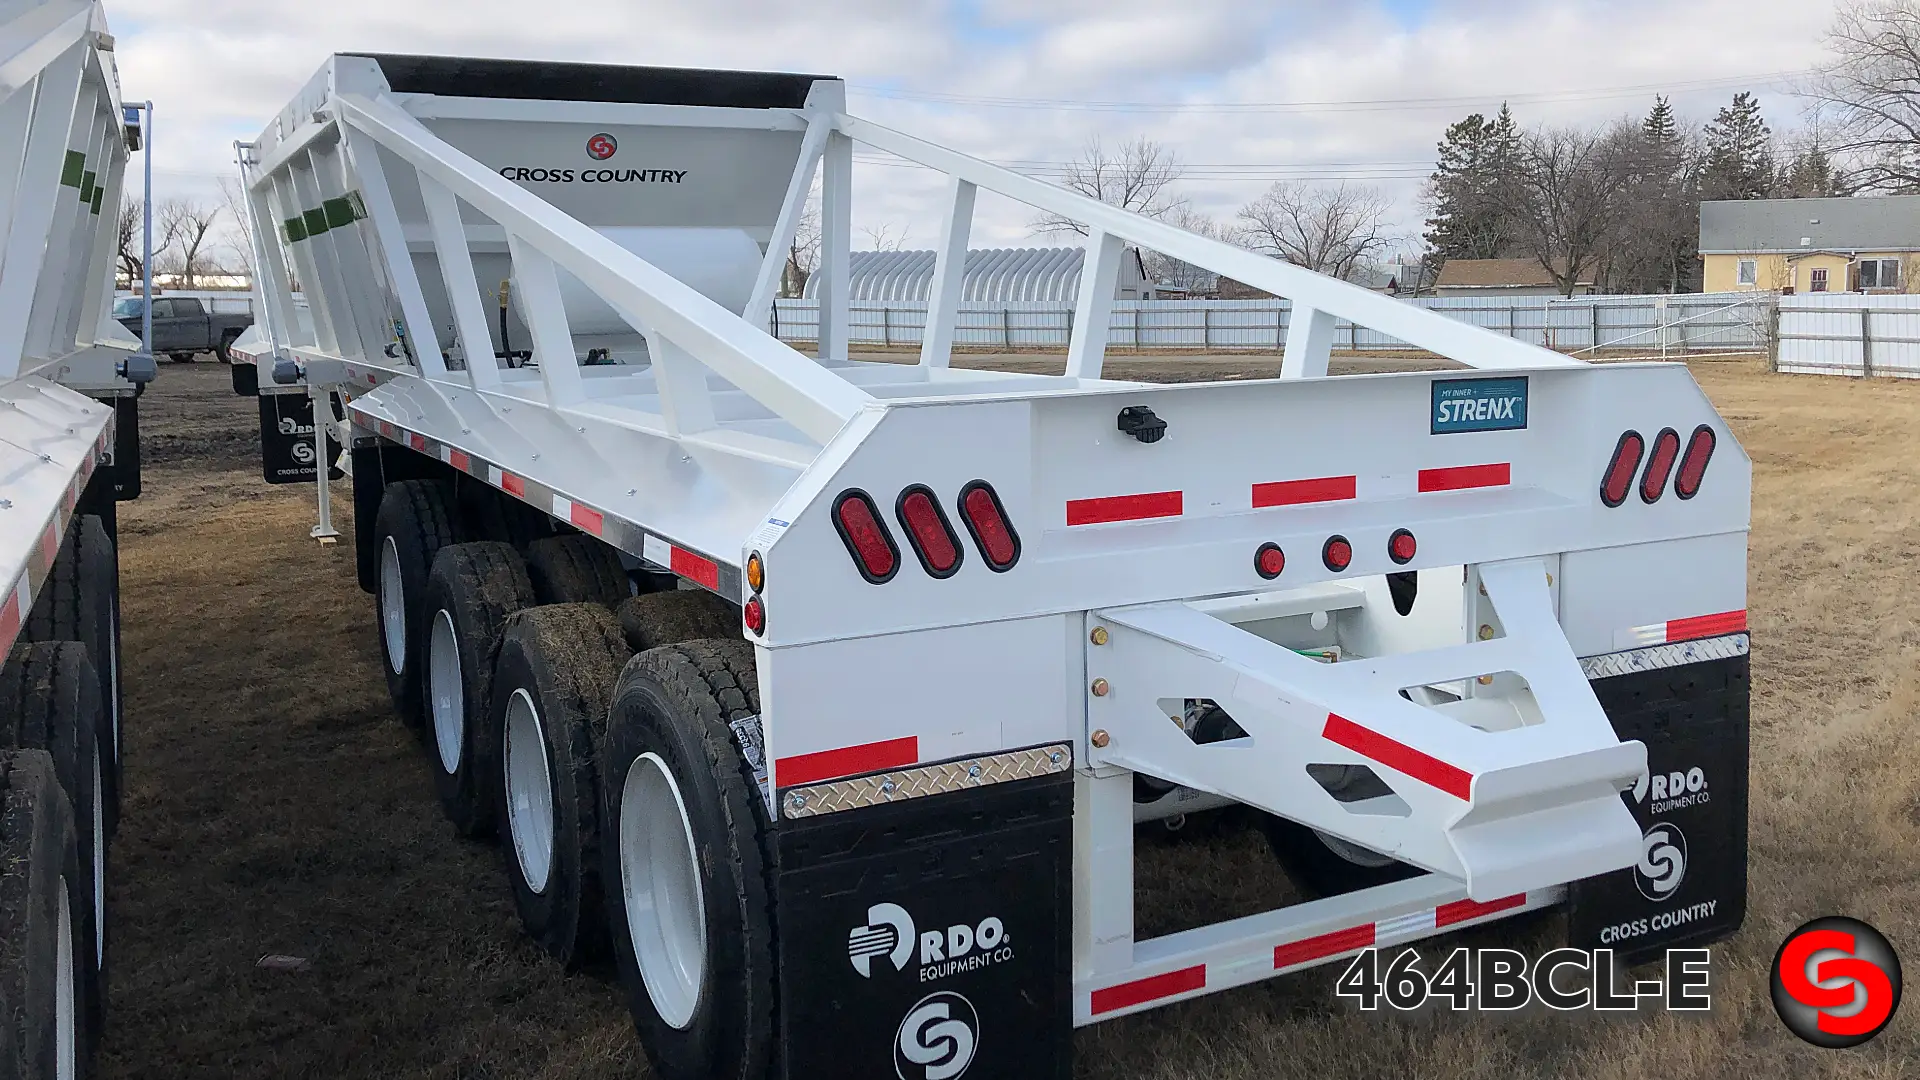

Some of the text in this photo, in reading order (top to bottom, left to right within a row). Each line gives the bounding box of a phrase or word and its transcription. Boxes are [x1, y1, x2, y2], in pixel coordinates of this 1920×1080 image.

[500, 167, 688, 183] CROSS COUNTRY
[1651, 792, 1711, 815] EQUIPMENT CO.
[1600, 900, 1717, 944] CROSS COUNTRY
[919, 947, 1015, 983] EQUIPMENT CO.
